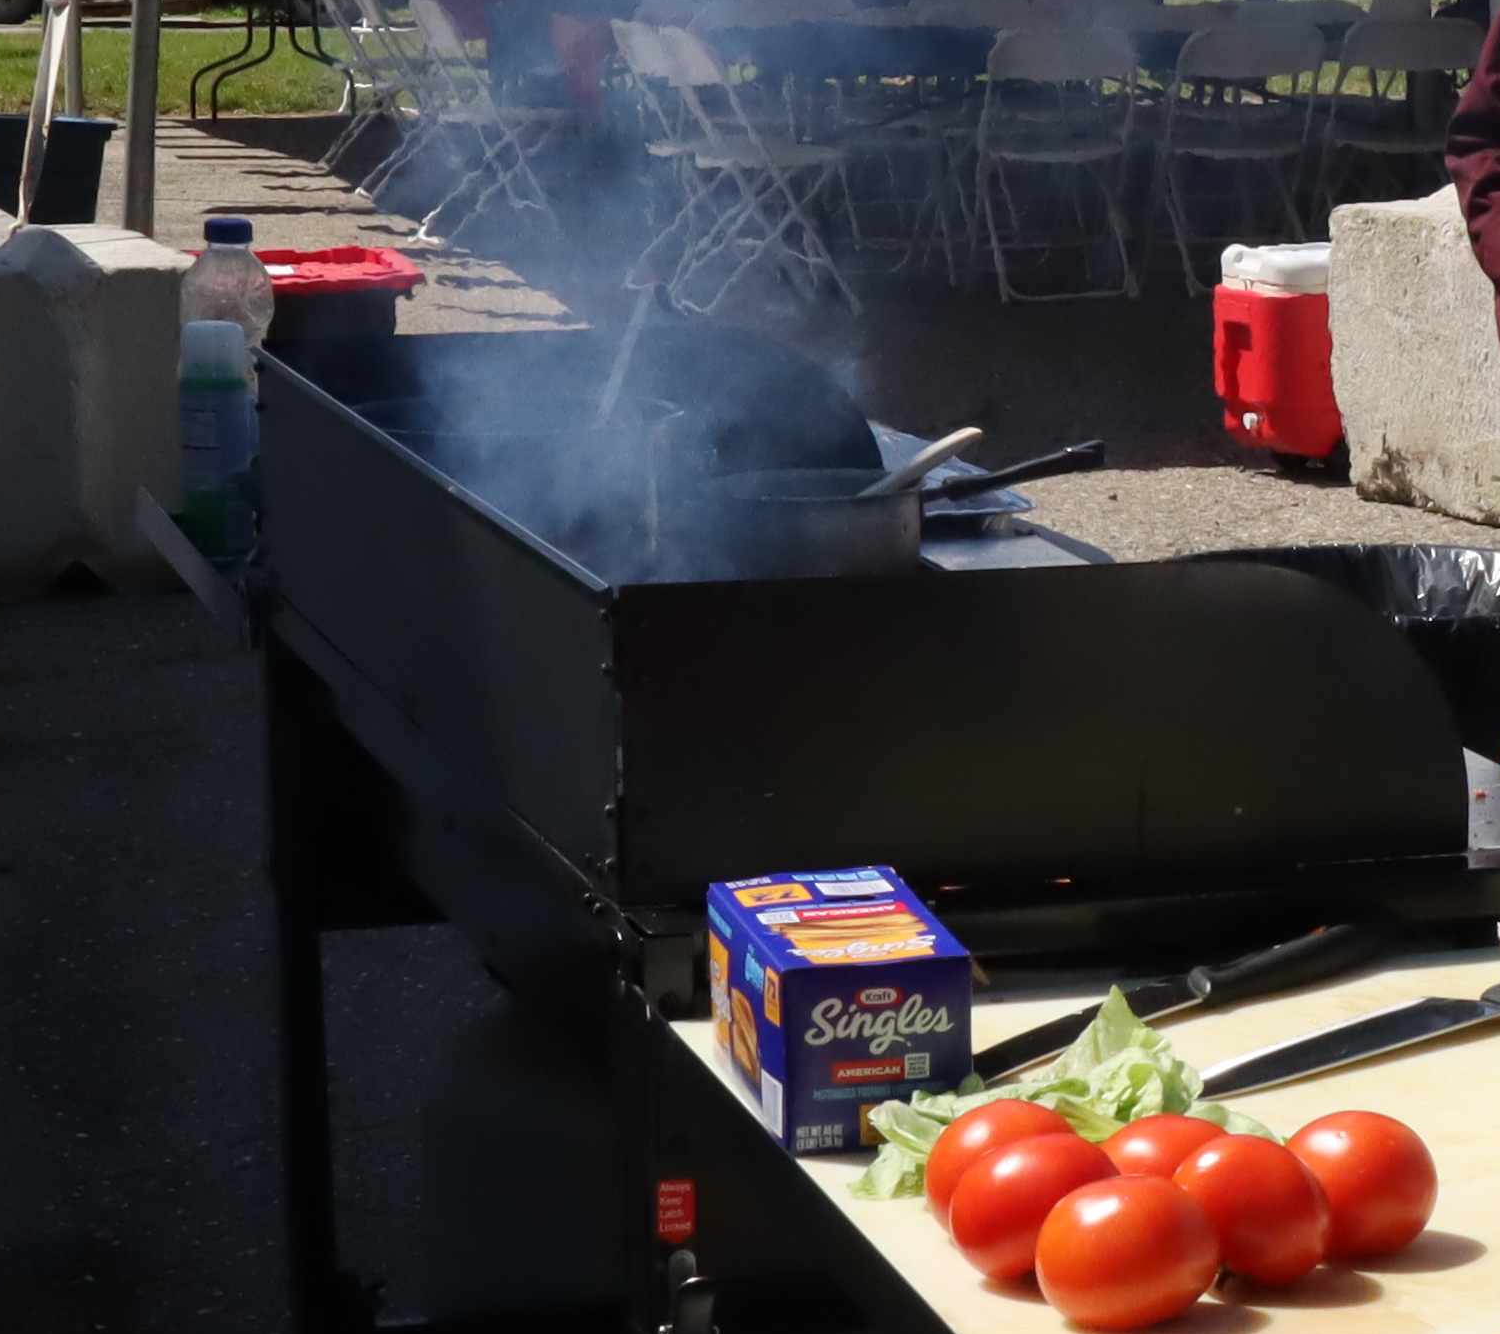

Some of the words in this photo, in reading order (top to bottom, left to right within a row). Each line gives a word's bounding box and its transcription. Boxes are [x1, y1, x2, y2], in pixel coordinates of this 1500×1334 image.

[802, 904, 897, 918] AMERICAN
[785, 934, 937, 959] Singles
[864, 988, 893, 1002] Kraft
[803, 993, 955, 1055] Singles
[837, 1065, 902, 1078] AMERICAN
[659, 1182, 691, 1194] Always
[659, 1197, 684, 1206] Keep
[659, 1208, 684, 1219] Latch
